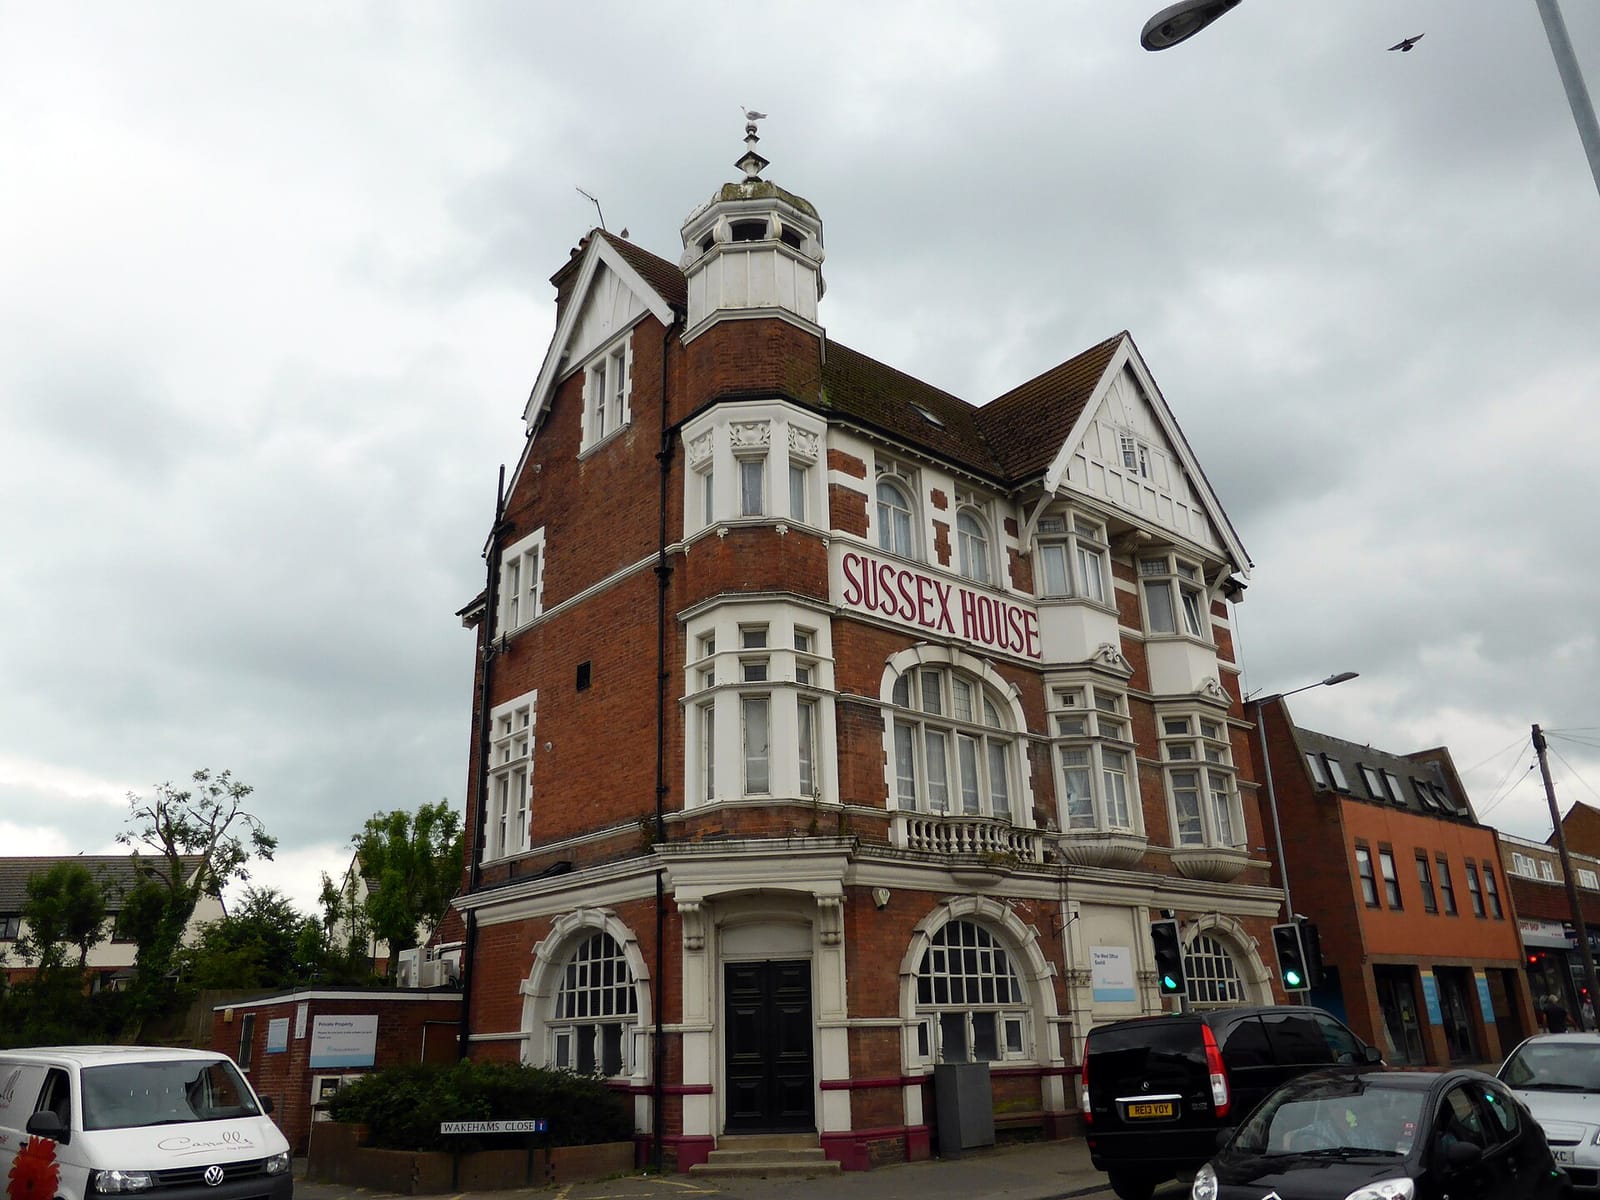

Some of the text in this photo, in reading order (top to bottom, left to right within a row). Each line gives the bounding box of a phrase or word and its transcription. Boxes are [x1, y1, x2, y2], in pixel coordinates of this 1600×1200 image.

[842, 552, 1042, 659] SUSSEX HOUSE
[1135, 1103, 1169, 1115] RE13 VOY
[444, 1121, 534, 1132] WAKEHAMS CLOSE
